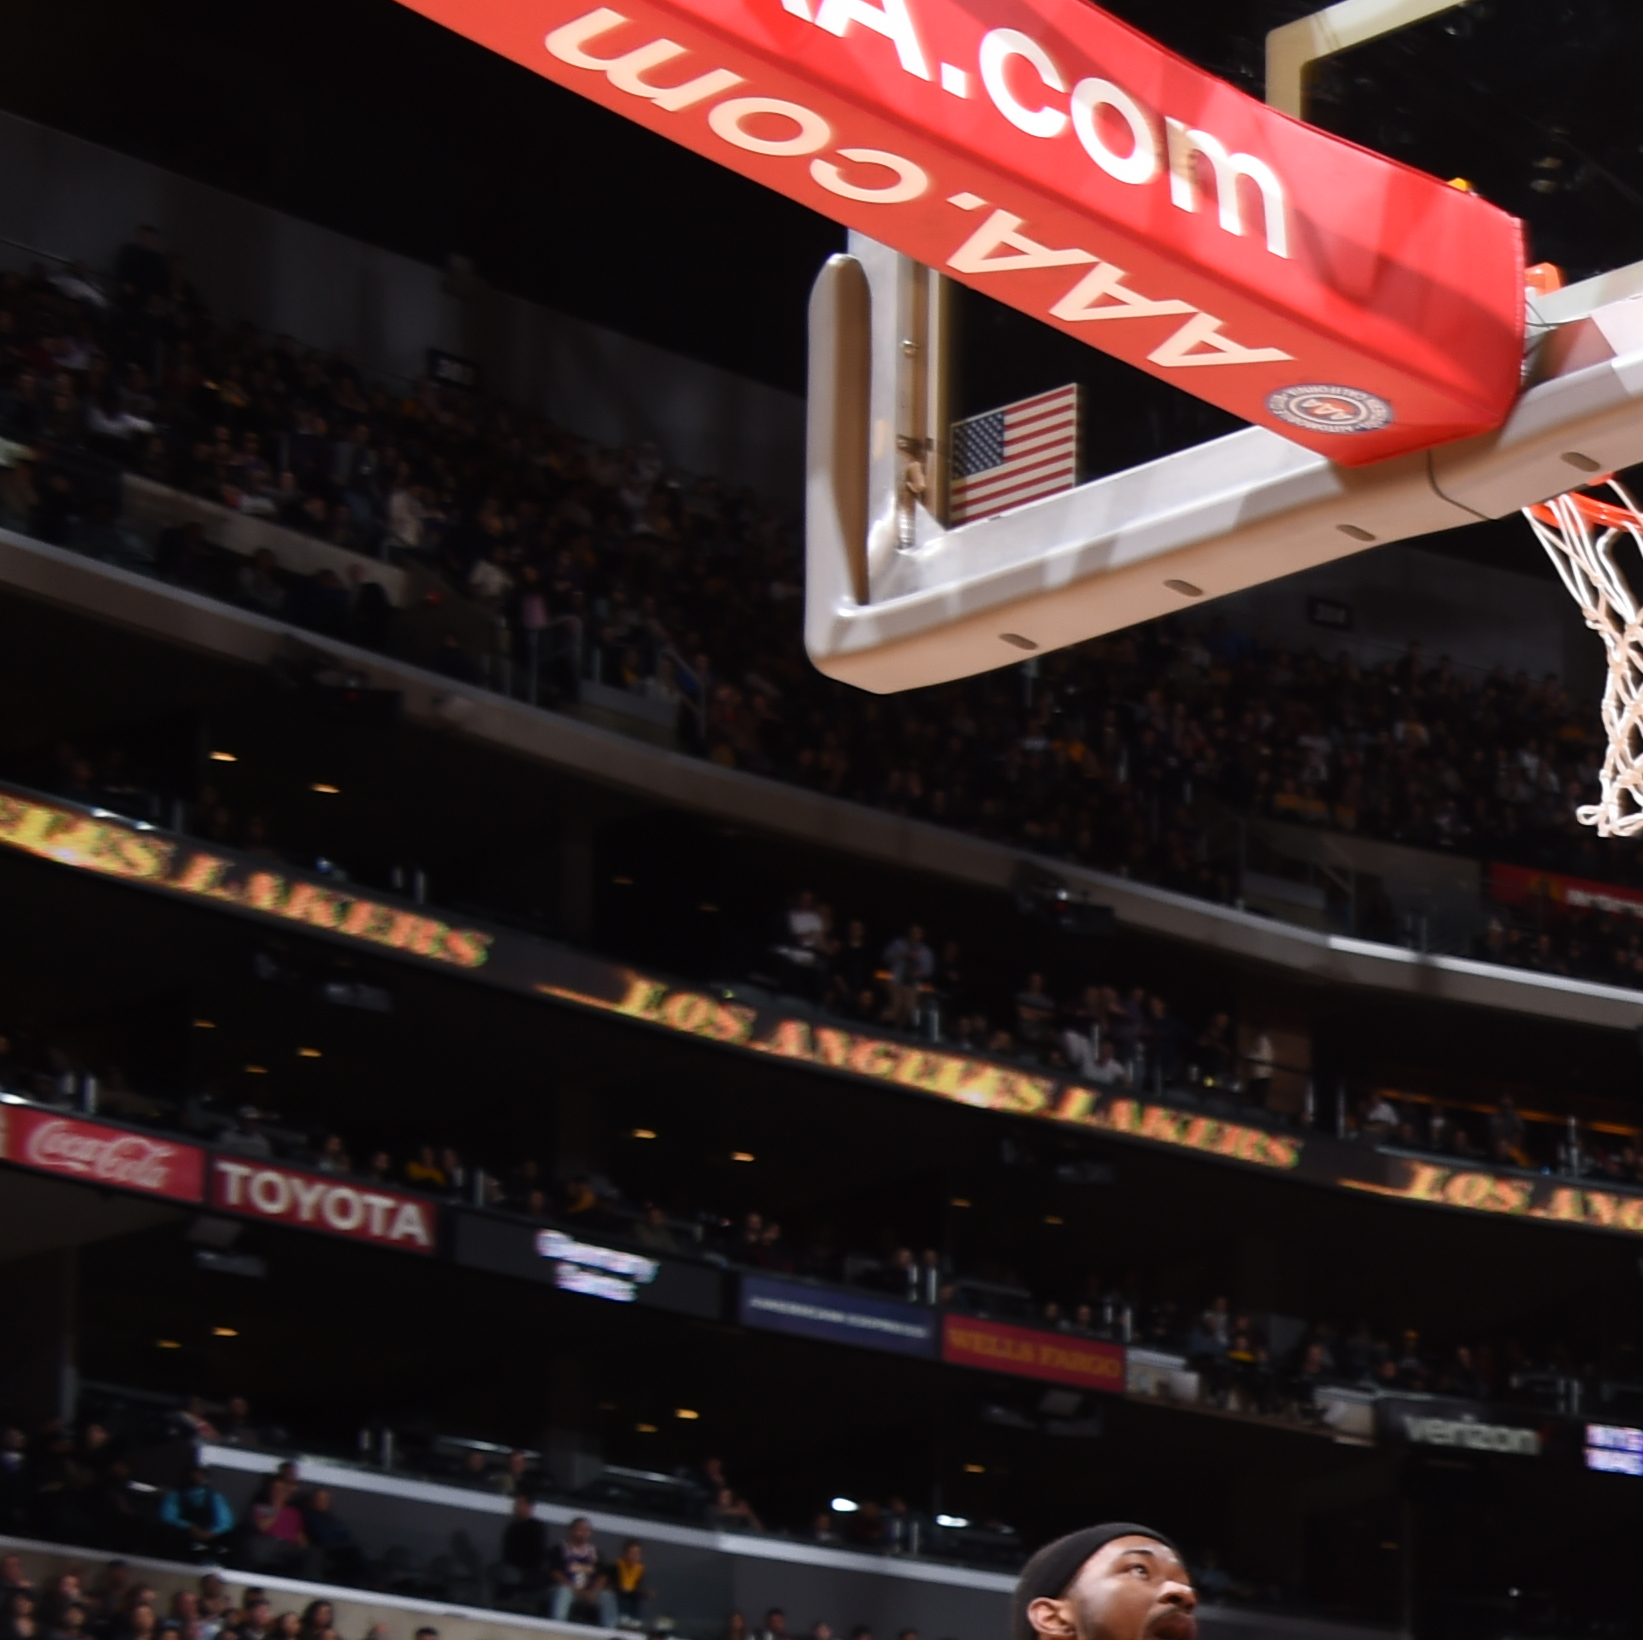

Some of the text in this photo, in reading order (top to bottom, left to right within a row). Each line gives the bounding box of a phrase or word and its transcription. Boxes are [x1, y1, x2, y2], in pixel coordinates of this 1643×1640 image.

[545, 11, 1298, 370] AAA.com
[176, 853, 494, 968] LAKERS
[616, 977, 1302, 1170] LOS ANGELES LAKERS
[28, 1119, 176, 1189] Coca-Cola
[1407, 1162, 1534, 1213] LOS
[213, 1160, 432, 1248] TOYOTA
[946, 1326, 1122, 1380] WELLS FARGO
[1403, 1411, 1542, 1457] verizon
